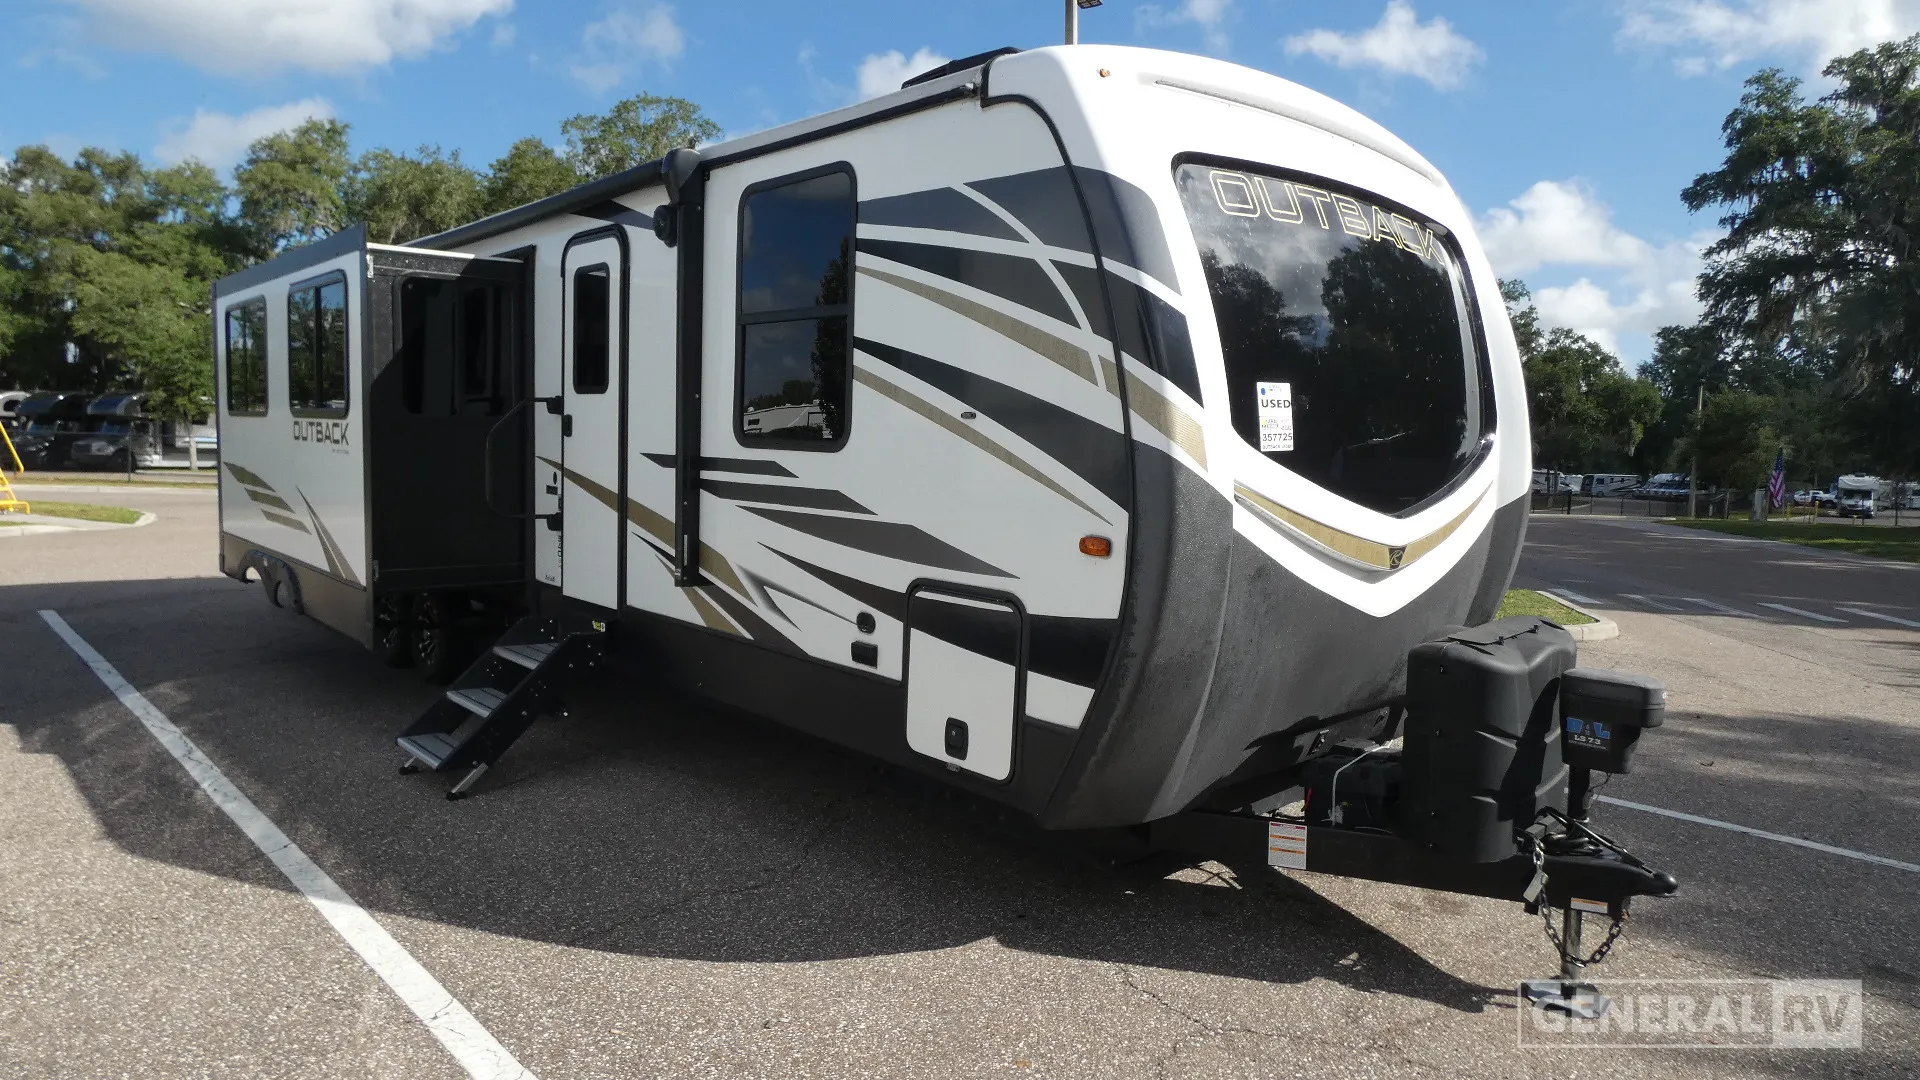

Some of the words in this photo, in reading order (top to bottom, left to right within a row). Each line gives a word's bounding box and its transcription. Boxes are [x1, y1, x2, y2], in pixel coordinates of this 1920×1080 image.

[1209, 170, 1445, 266] OUTBACK
[1261, 399, 1291, 408] USED
[294, 421, 349, 446] OUTBACK
[1262, 433, 1293, 442] 357725
